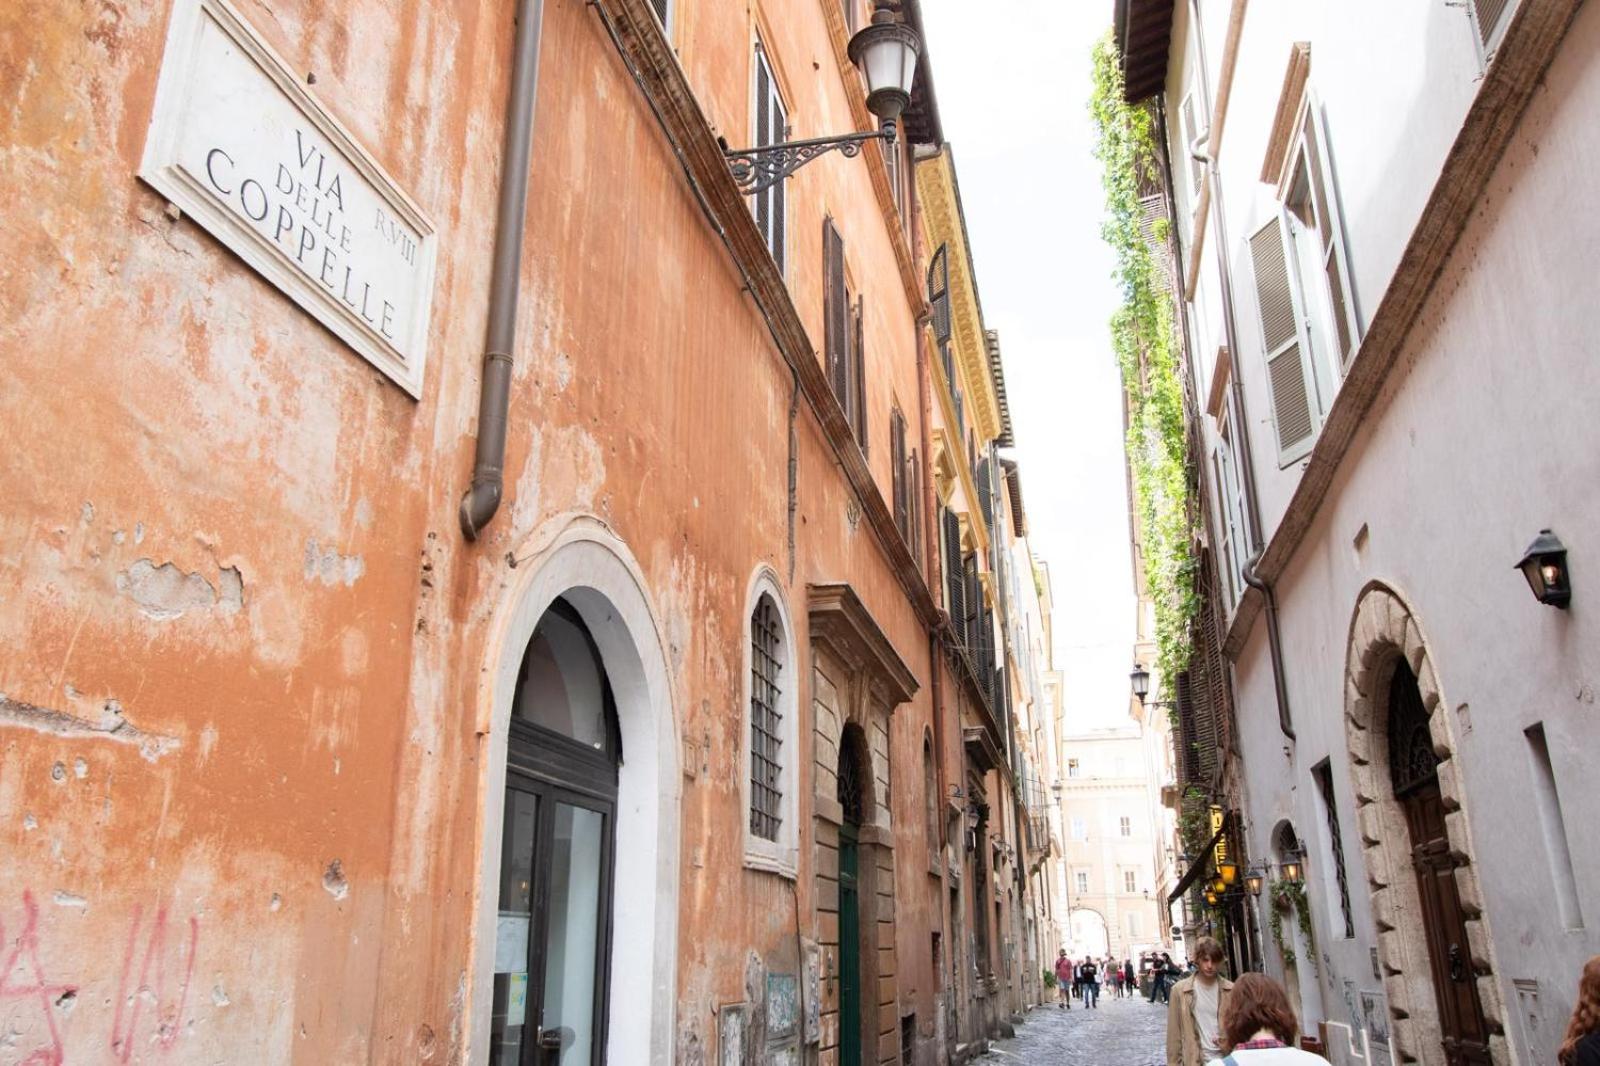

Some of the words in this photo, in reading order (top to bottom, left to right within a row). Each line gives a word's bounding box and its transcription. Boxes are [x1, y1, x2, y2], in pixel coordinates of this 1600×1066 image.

[275, 163, 352, 254] DELLE
[296, 129, 344, 213] VIA
[206, 147, 396, 340] COPPELLE
